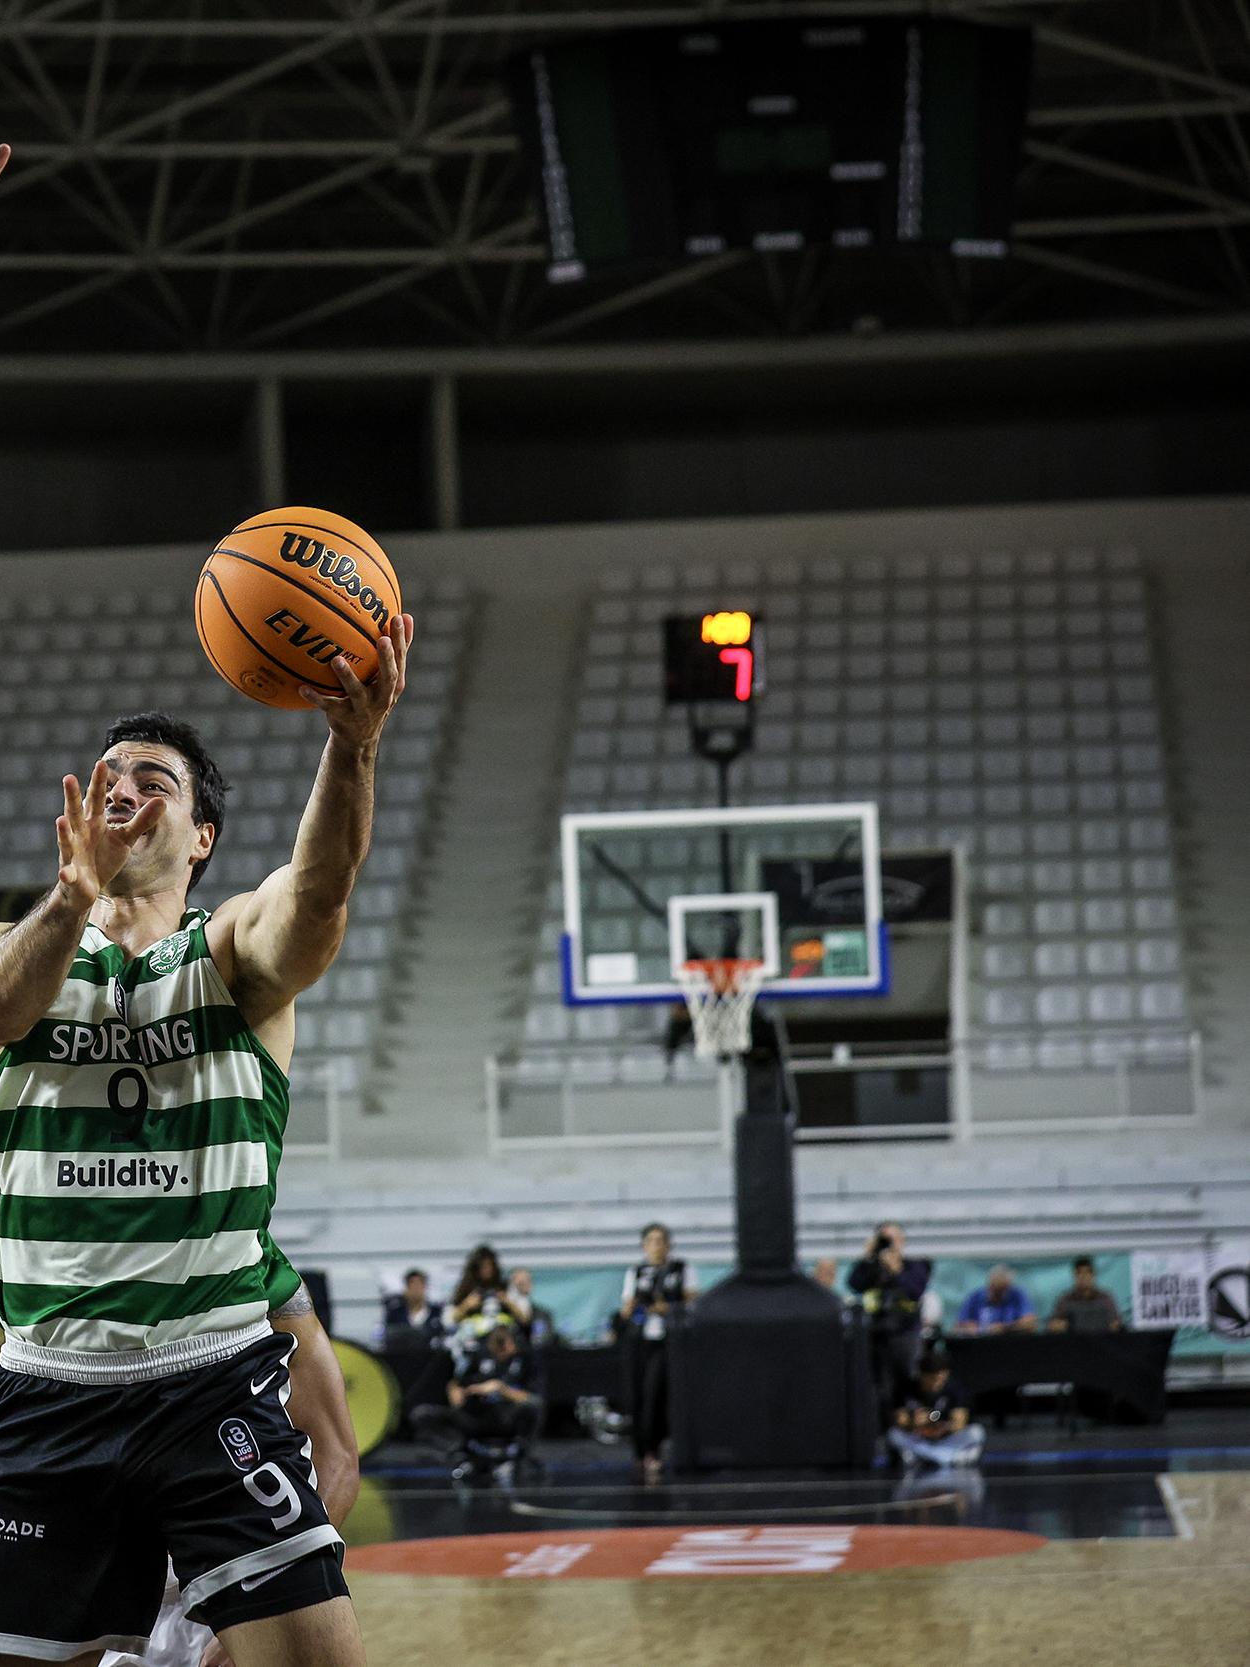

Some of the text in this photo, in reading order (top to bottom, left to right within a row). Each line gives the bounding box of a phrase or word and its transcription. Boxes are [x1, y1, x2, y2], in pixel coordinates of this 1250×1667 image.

[279, 531, 390, 634] Wilson
[49, 1018, 195, 1064] SPORING
[107, 1067, 149, 1143] 9
[56, 1159, 189, 1193] Buildity.
[243, 1461, 302, 1531] 9
